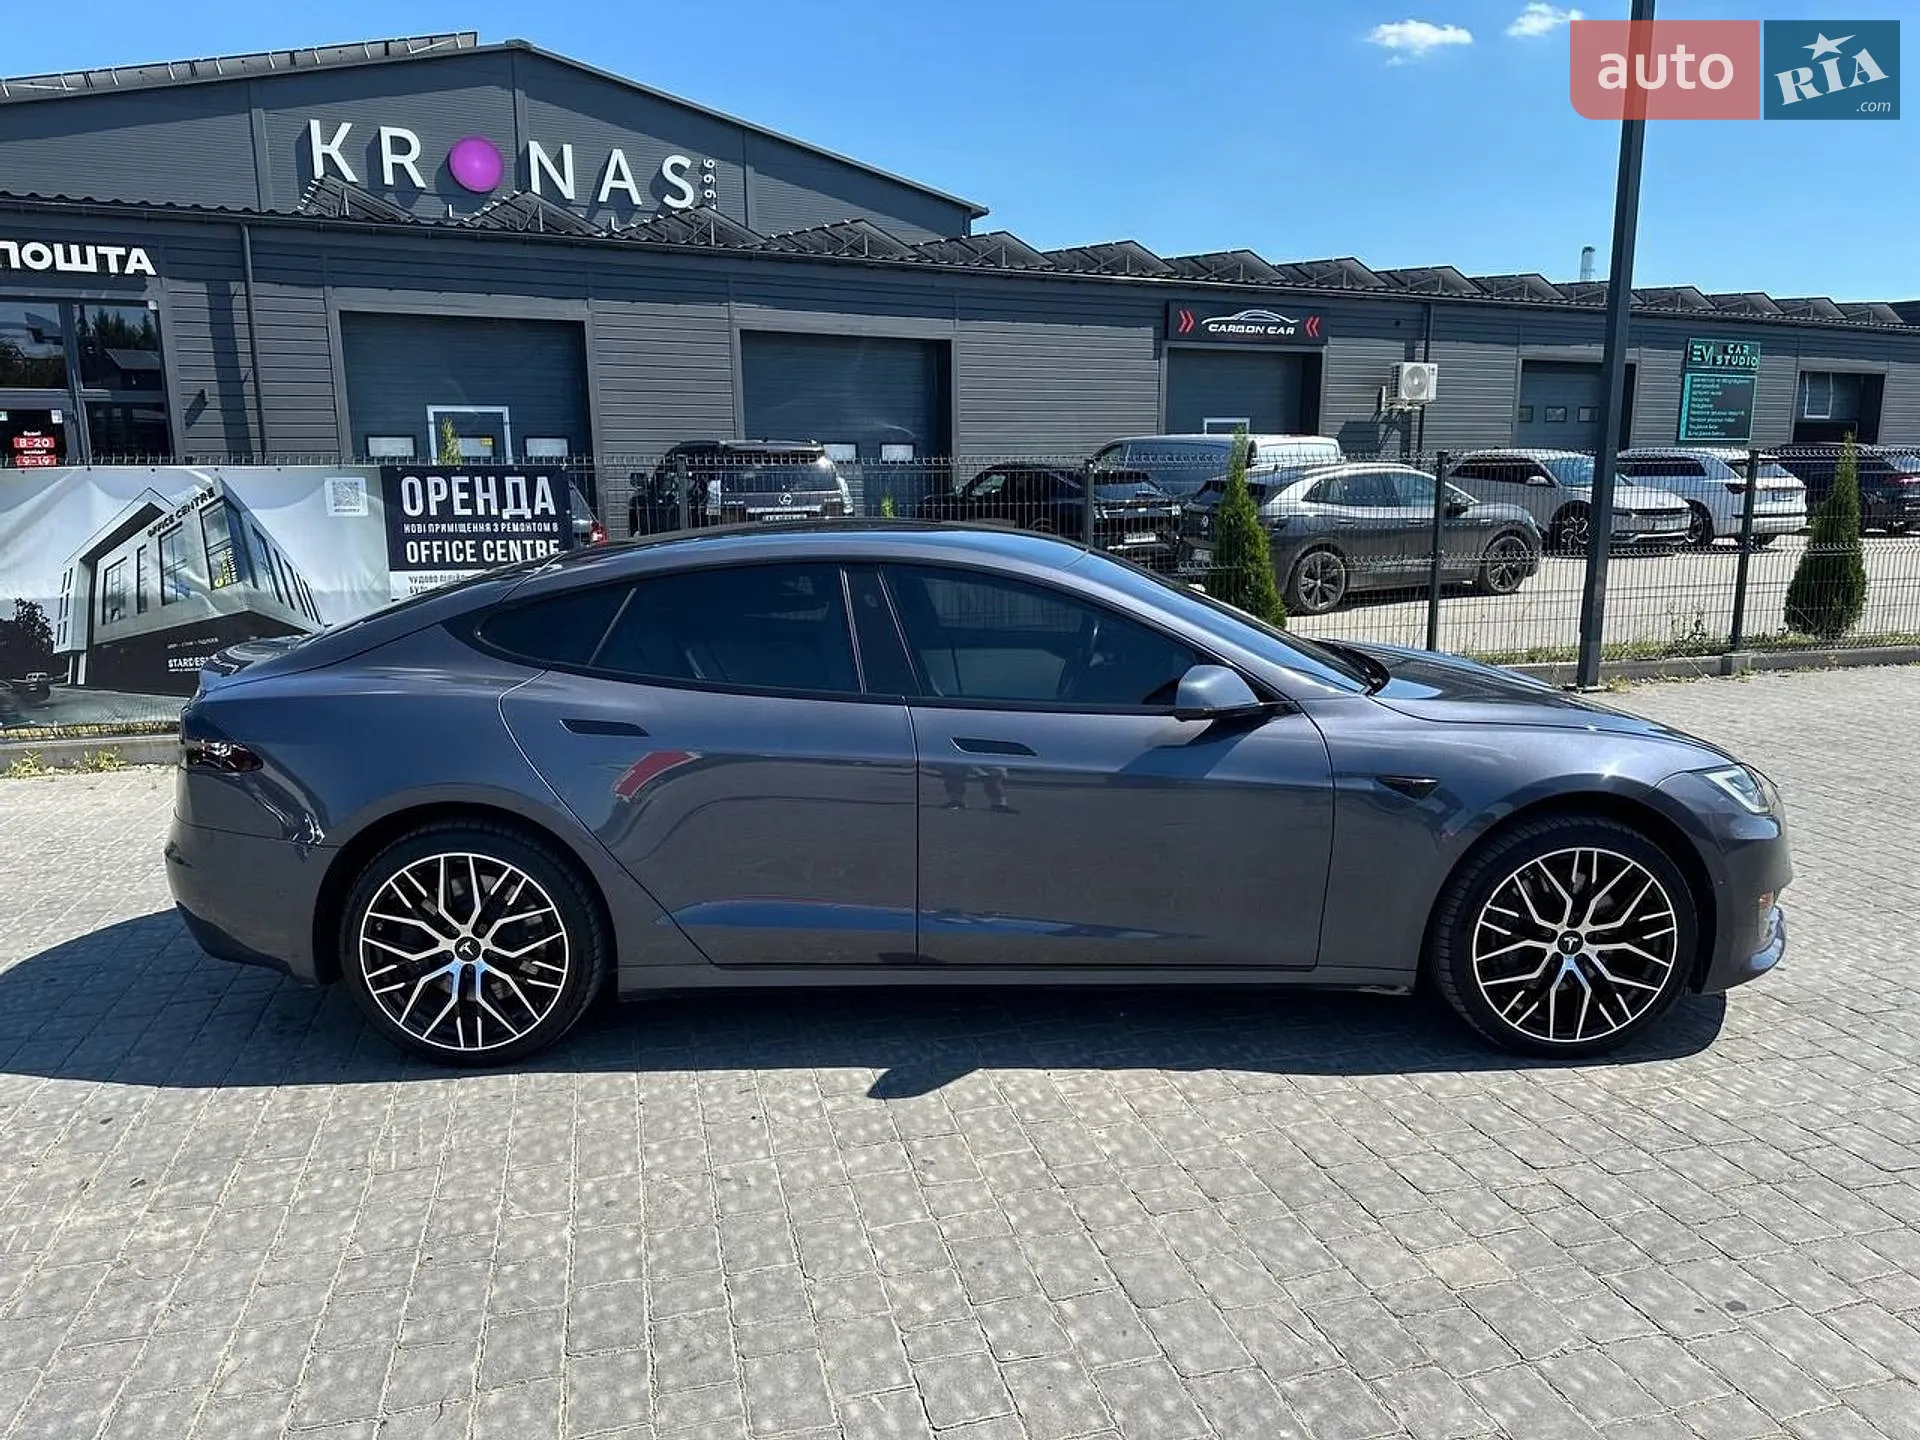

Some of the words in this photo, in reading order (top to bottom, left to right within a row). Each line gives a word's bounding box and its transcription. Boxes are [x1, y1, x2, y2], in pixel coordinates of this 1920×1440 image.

[308, 119, 695, 209] KRONAS
[703, 159, 717, 210] 996
[0, 240, 157, 276] ПОШТА
[1208, 323, 1264, 334] CARBON
[1267, 325, 1296, 335] CAR
[1716, 355, 1759, 367] STUDIO
[1727, 344, 1749, 354] CAR
[401, 476, 557, 519] ОРЕНДА
[406, 540, 477, 563] OFFICE
